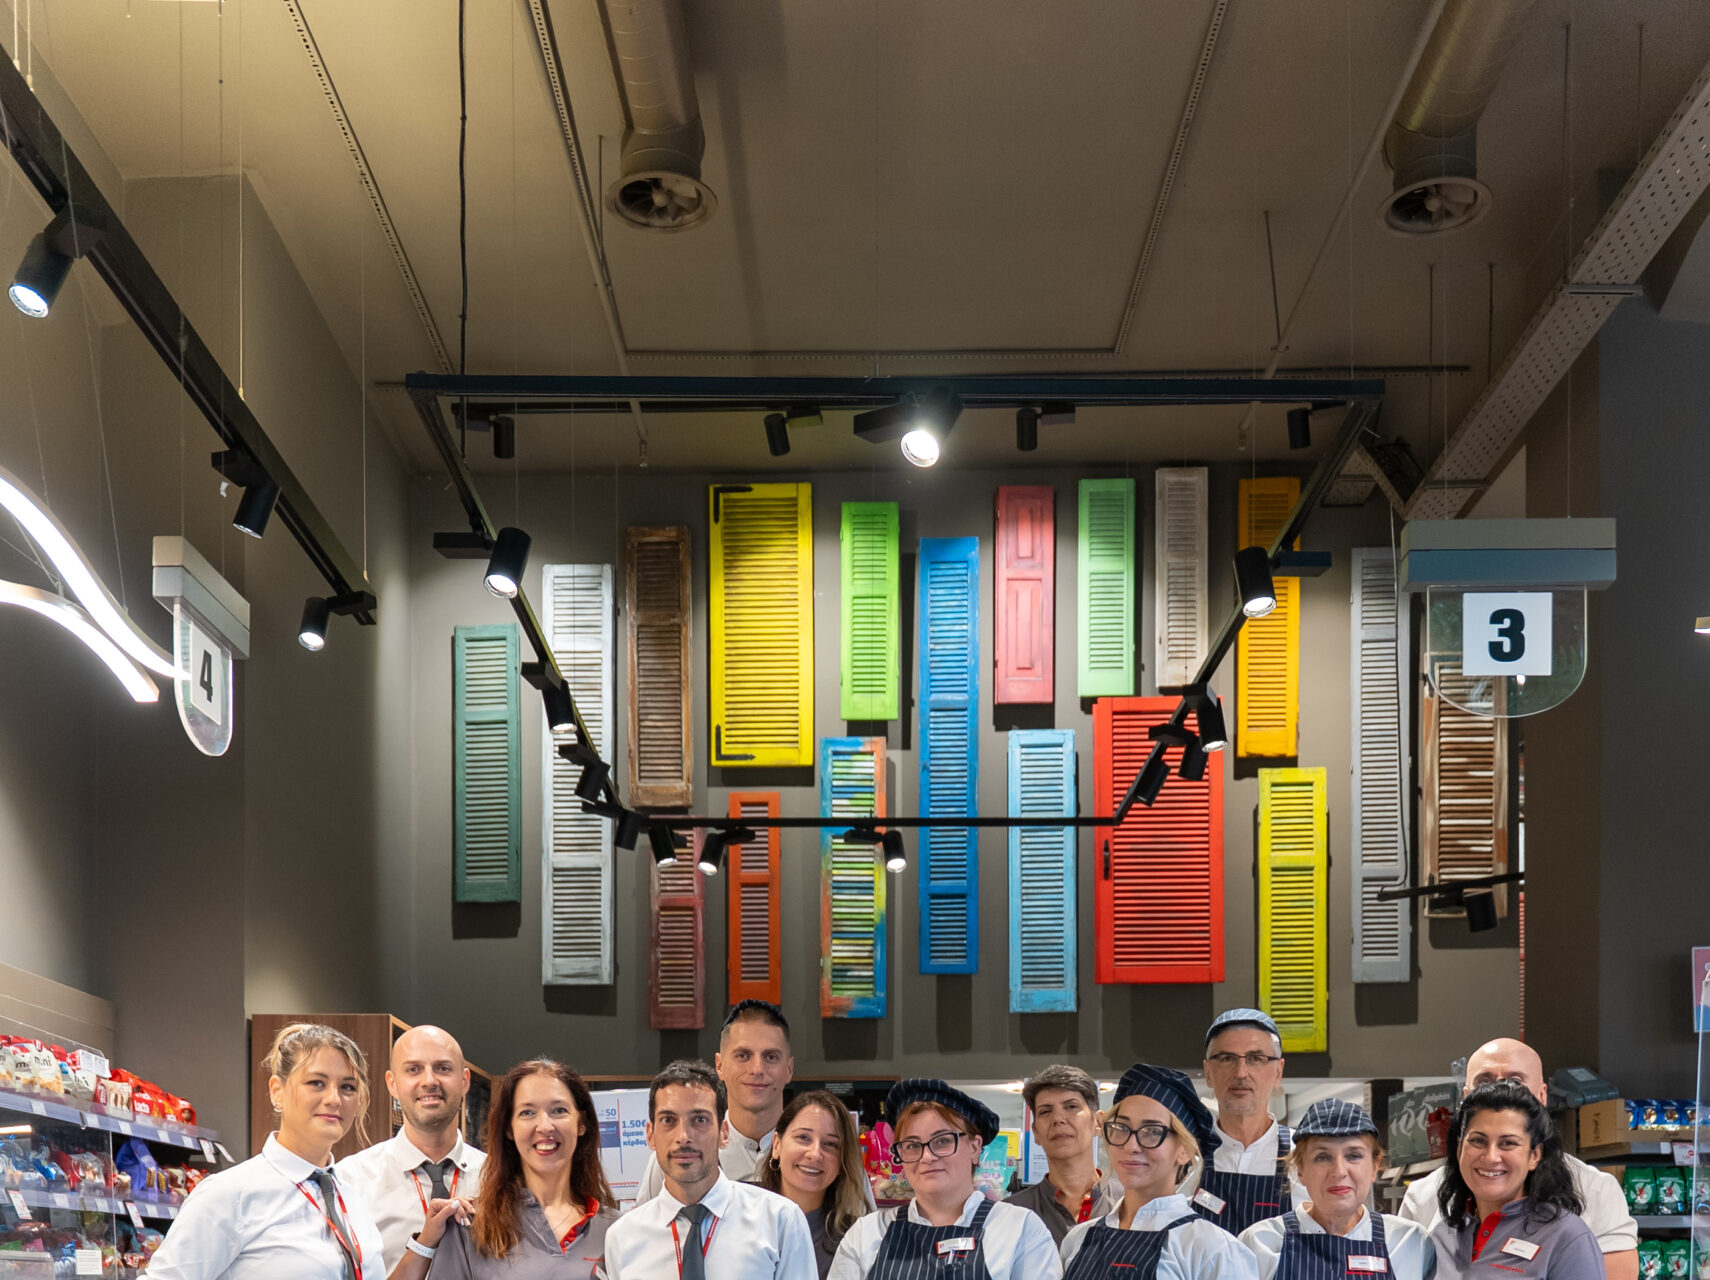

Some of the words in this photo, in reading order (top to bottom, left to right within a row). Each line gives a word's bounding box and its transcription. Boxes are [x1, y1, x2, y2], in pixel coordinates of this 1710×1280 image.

[1489, 608, 1525, 662] 3
[199, 649, 213, 702] 4
[605, 1108, 617, 1117] 50
